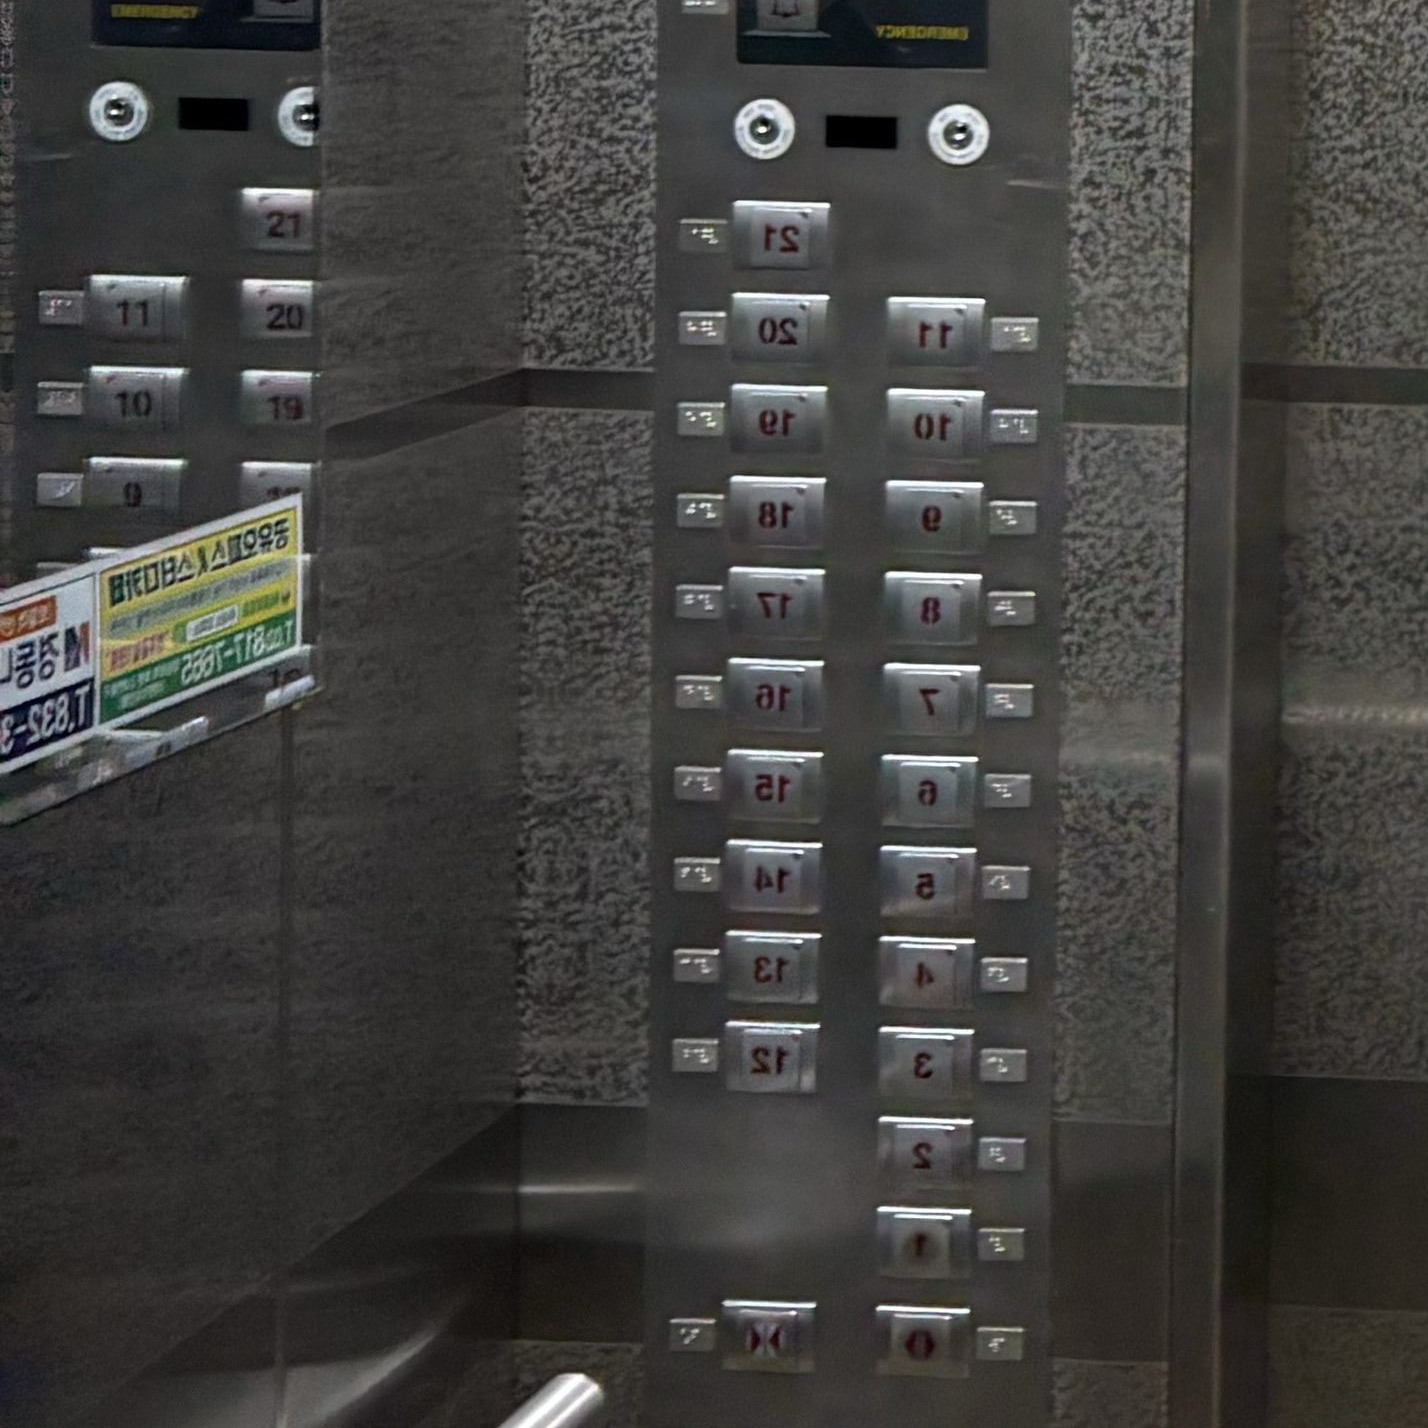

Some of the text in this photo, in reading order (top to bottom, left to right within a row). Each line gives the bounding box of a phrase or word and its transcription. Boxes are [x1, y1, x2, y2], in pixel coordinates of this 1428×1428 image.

[267, 212, 302, 239] 21
[117, 299, 150, 327] 11
[266, 303, 303, 331] 20
[116, 392, 152, 418] 10
[269, 396, 304, 422] 19
